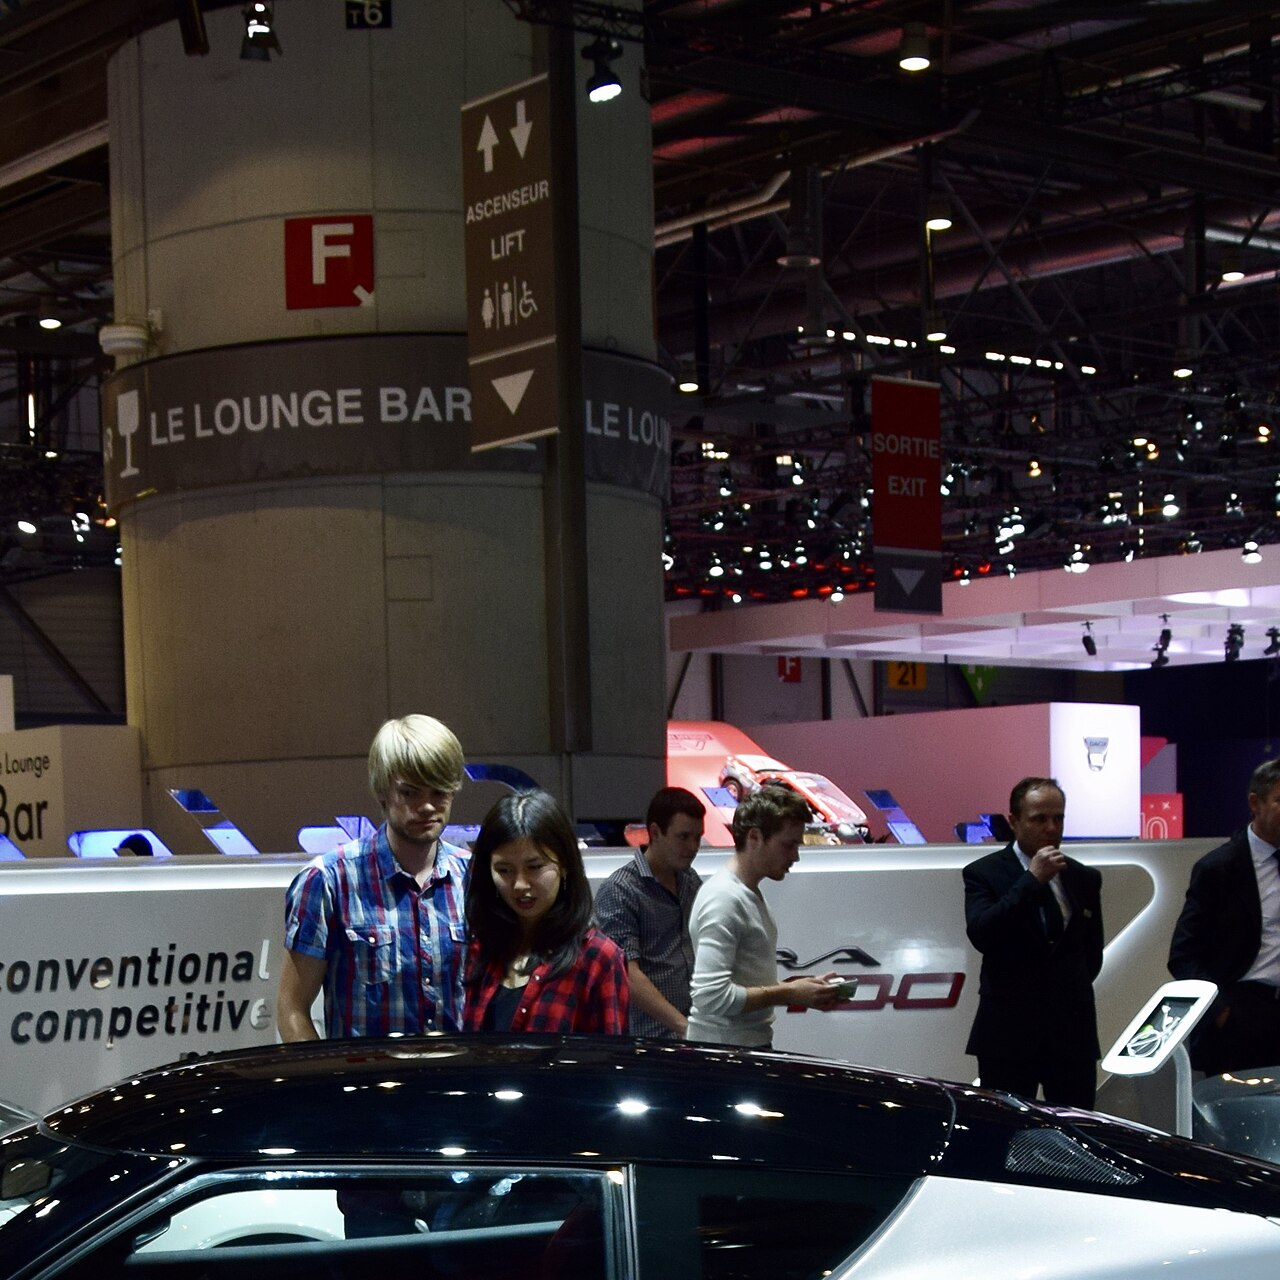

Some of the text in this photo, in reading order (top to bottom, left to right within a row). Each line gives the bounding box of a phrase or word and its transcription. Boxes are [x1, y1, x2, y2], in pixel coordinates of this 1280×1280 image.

[465, 179, 550, 225] ASCENSEUR
[311, 222, 355, 286] F
[490, 229, 526, 260] LIFT
[150, 406, 186, 446] LE
[194, 388, 365, 439] LOUNGE
[378, 386, 473, 424] BAR
[584, 399, 621, 438] LE
[873, 431, 940, 459] SORTIE
[887, 475, 927, 497] EXIT
[897, 661, 918, 687] 21
[6, 751, 51, 778] Lounge
[10, 990, 272, 1050] competitive
